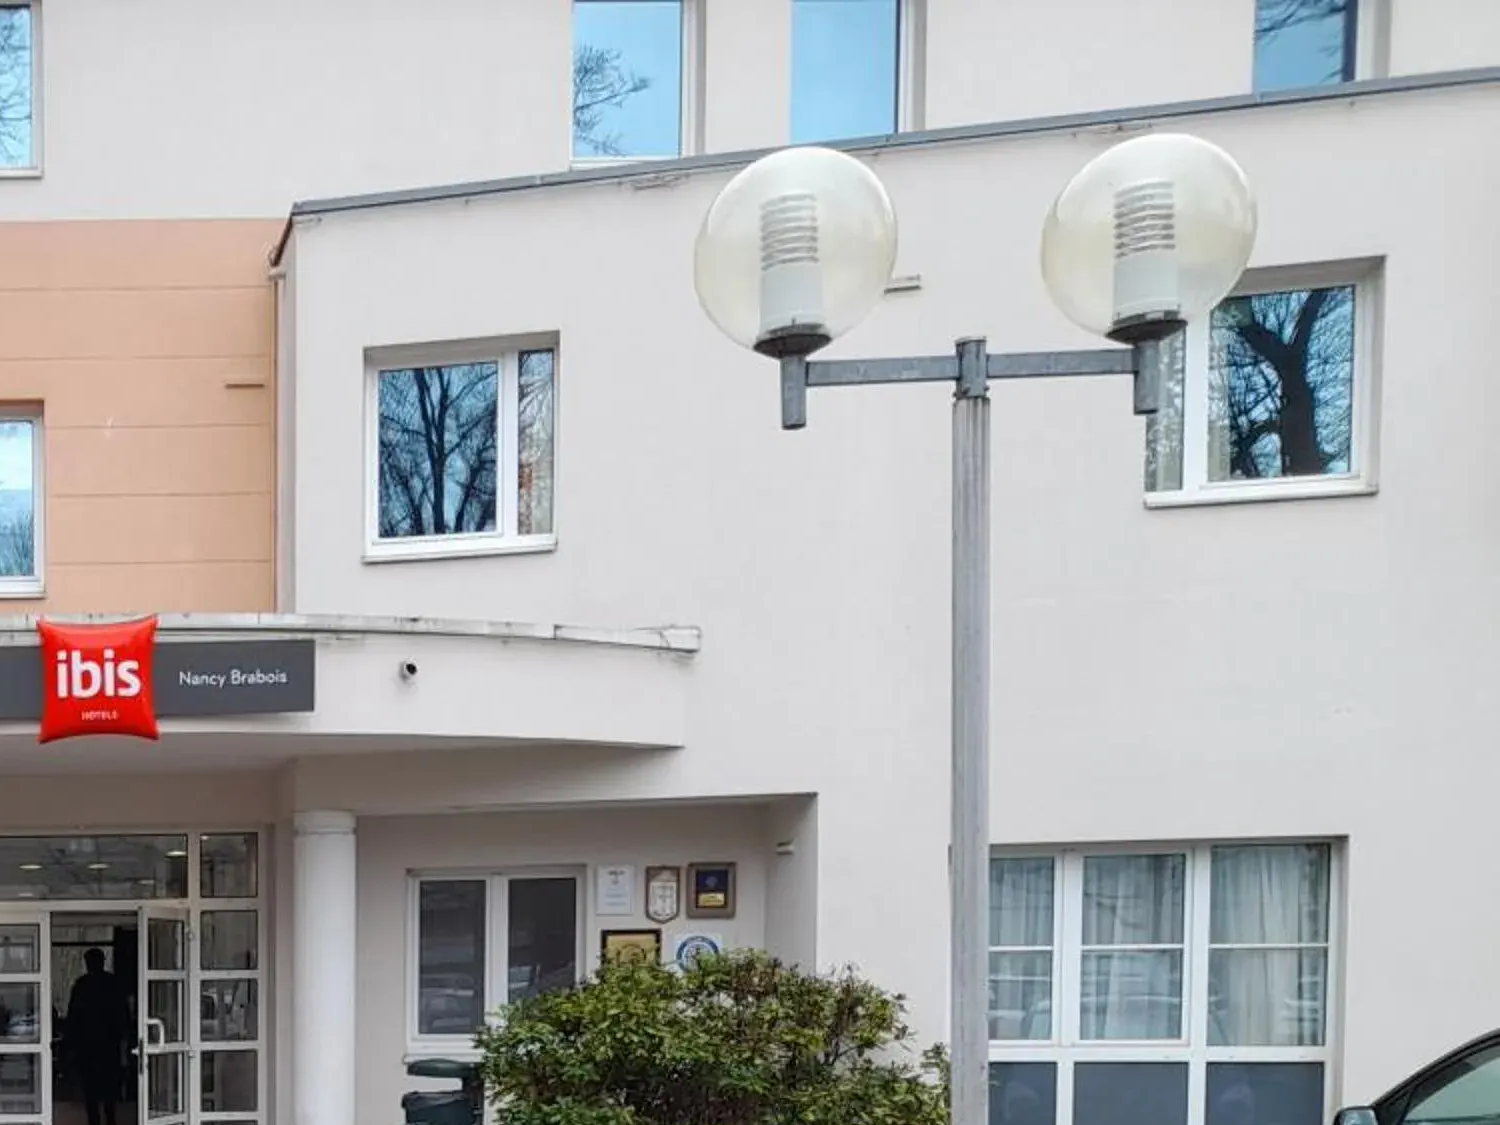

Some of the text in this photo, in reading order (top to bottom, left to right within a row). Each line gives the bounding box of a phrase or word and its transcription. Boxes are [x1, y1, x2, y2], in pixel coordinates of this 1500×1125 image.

[57, 648, 141, 699] ibis
[179, 667, 288, 688] Nancy Brabois
[81, 710, 119, 721] HOTELS
